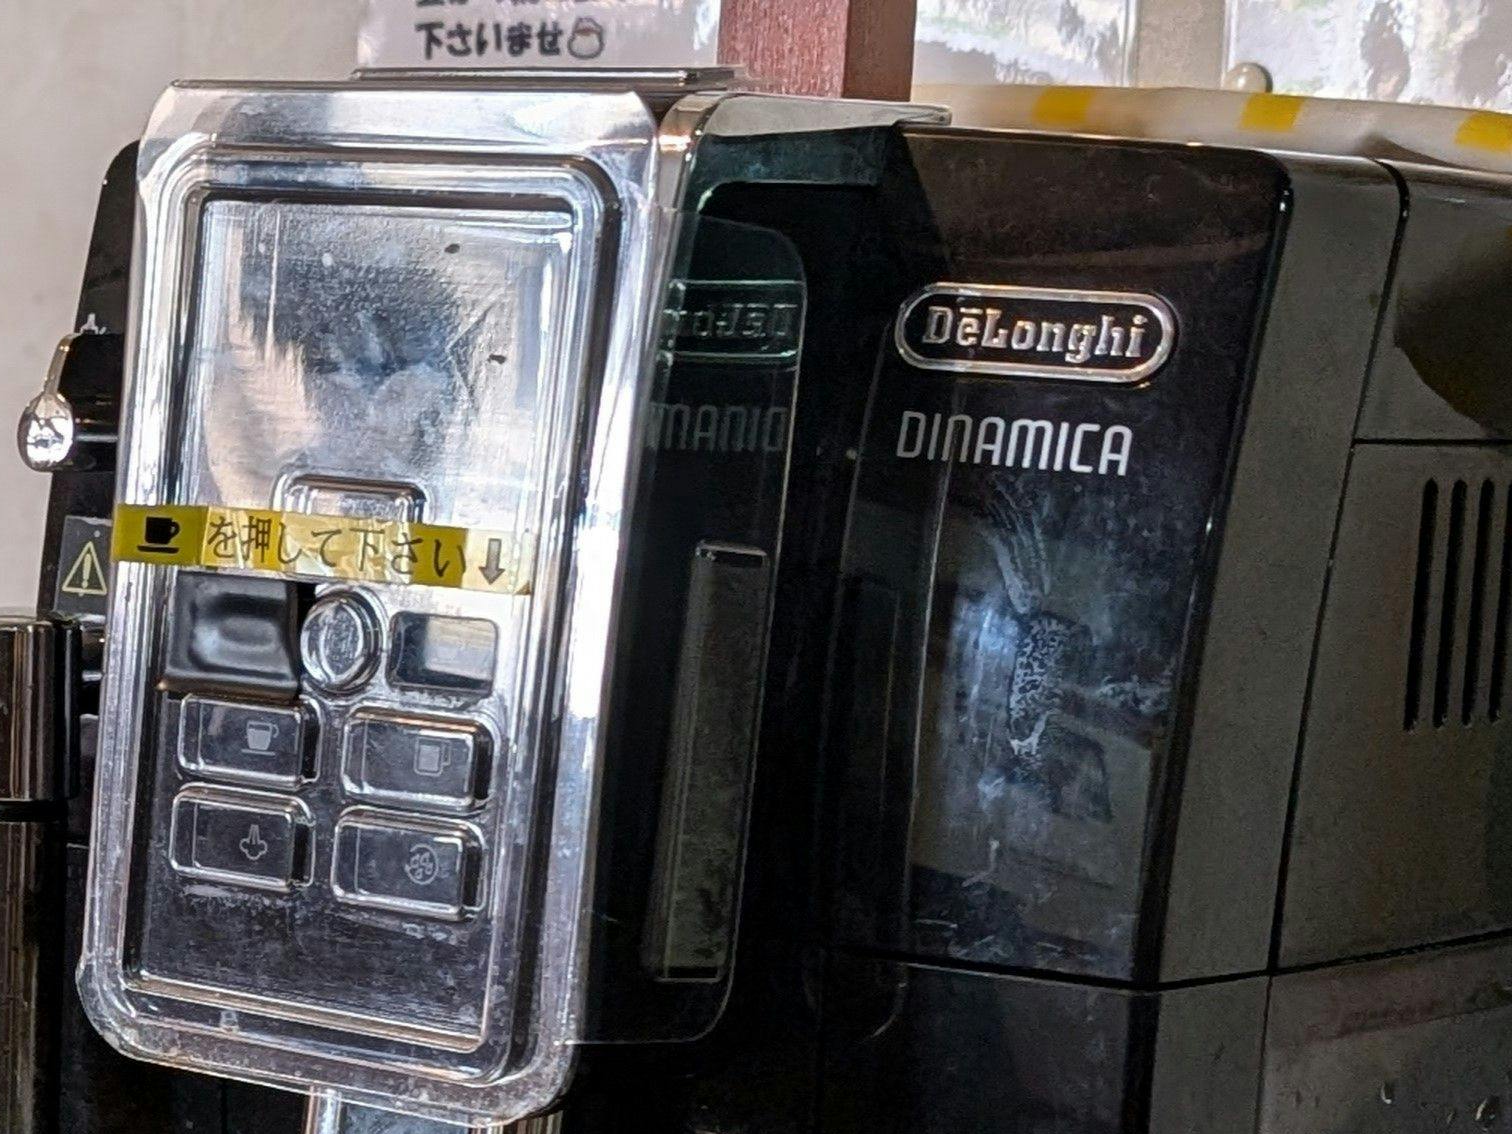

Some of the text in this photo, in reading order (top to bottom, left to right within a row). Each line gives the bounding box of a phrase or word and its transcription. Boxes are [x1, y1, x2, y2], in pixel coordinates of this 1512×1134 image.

[414, 20, 563, 60] 下さいませ
[896, 410, 1134, 477] DINAMICA
[207, 515, 467, 579] を押して下さい
